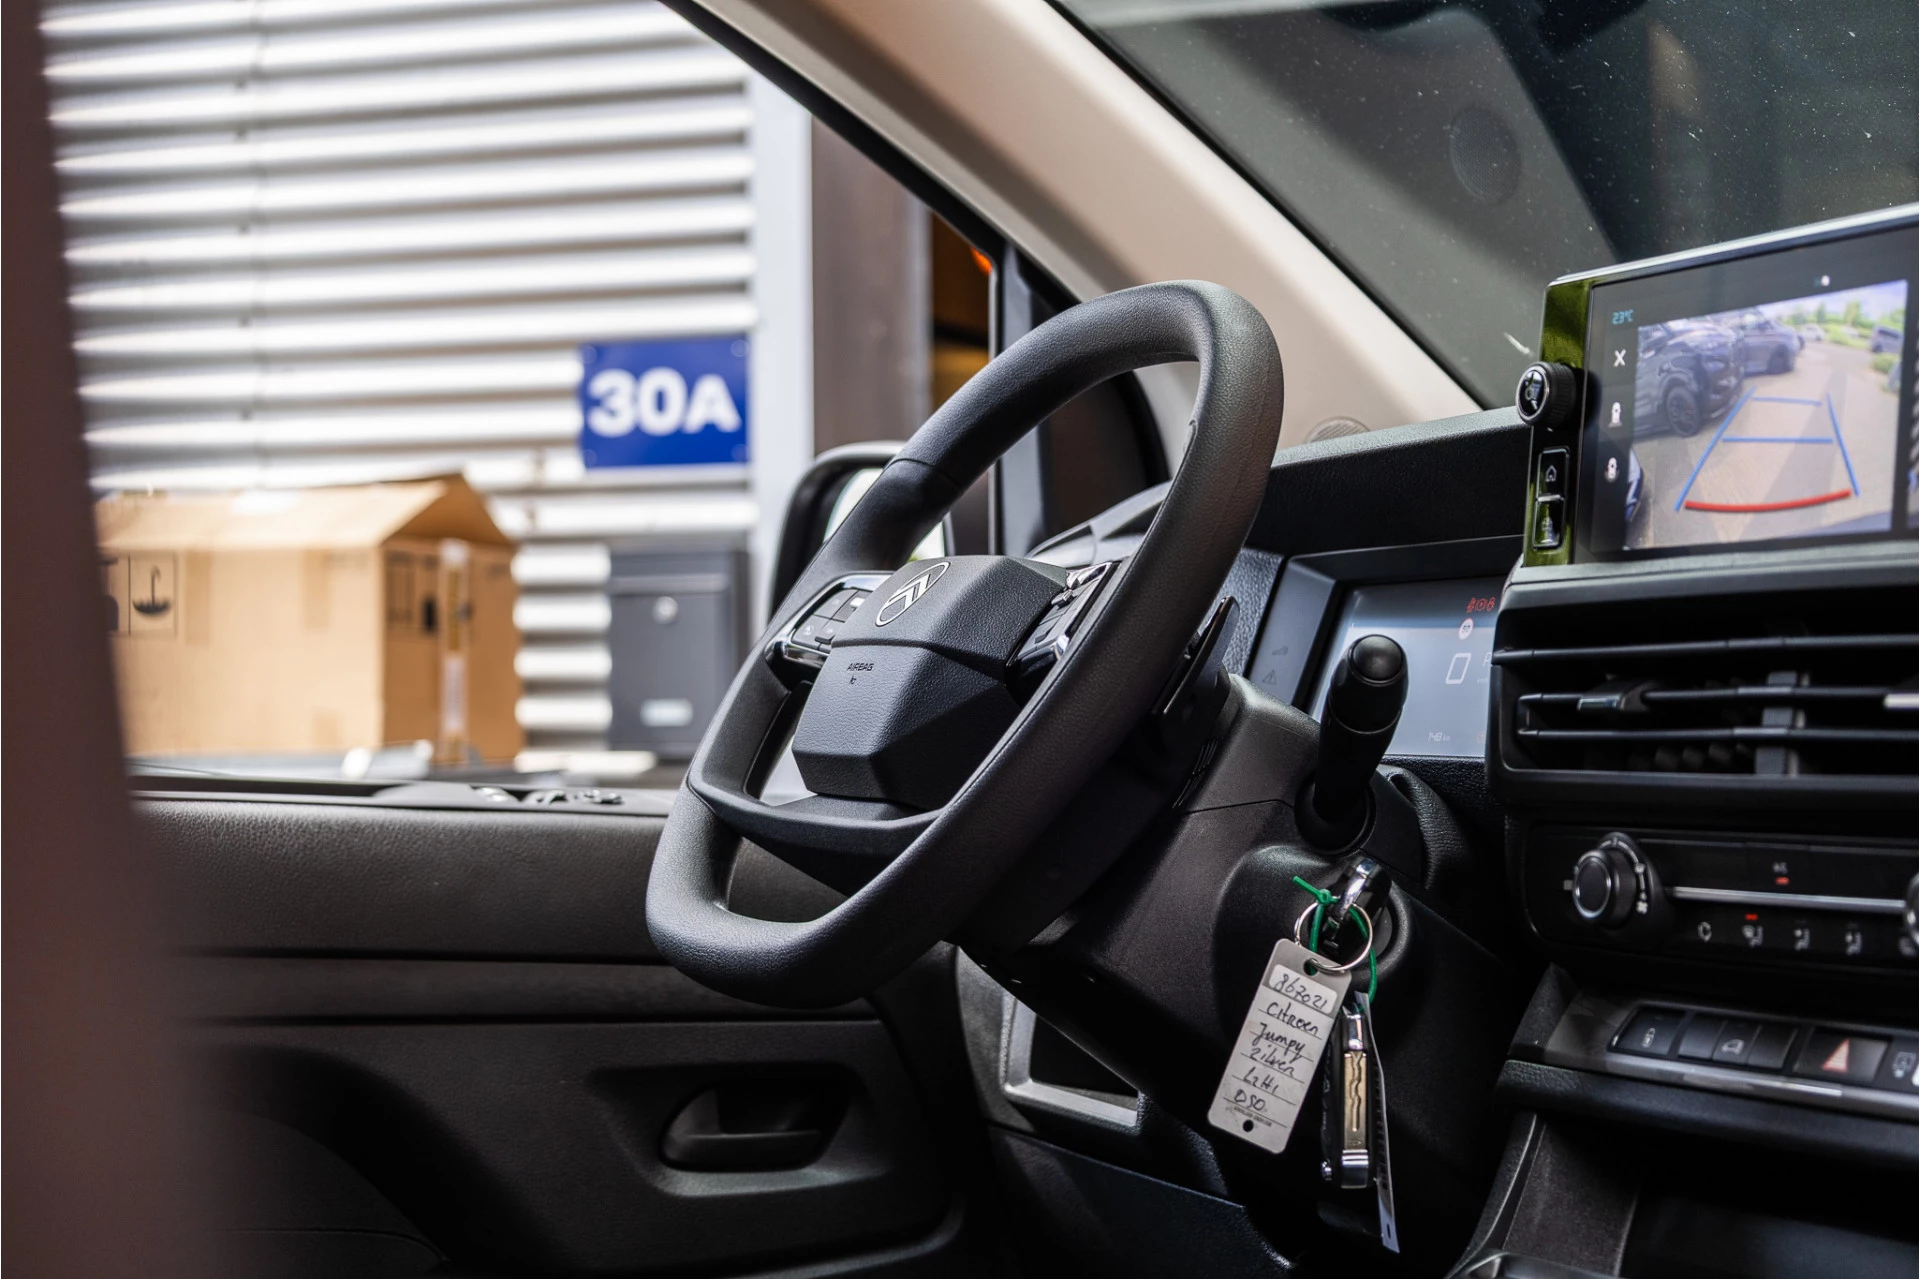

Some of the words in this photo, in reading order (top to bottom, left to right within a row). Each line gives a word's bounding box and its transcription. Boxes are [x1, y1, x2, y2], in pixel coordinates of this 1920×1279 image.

[587, 366, 743, 438] 30A
[847, 662, 875, 671] AIRBAG
[1273, 973, 1328, 1010] 867021
[1251, 1021, 1306, 1064] Jumpy
